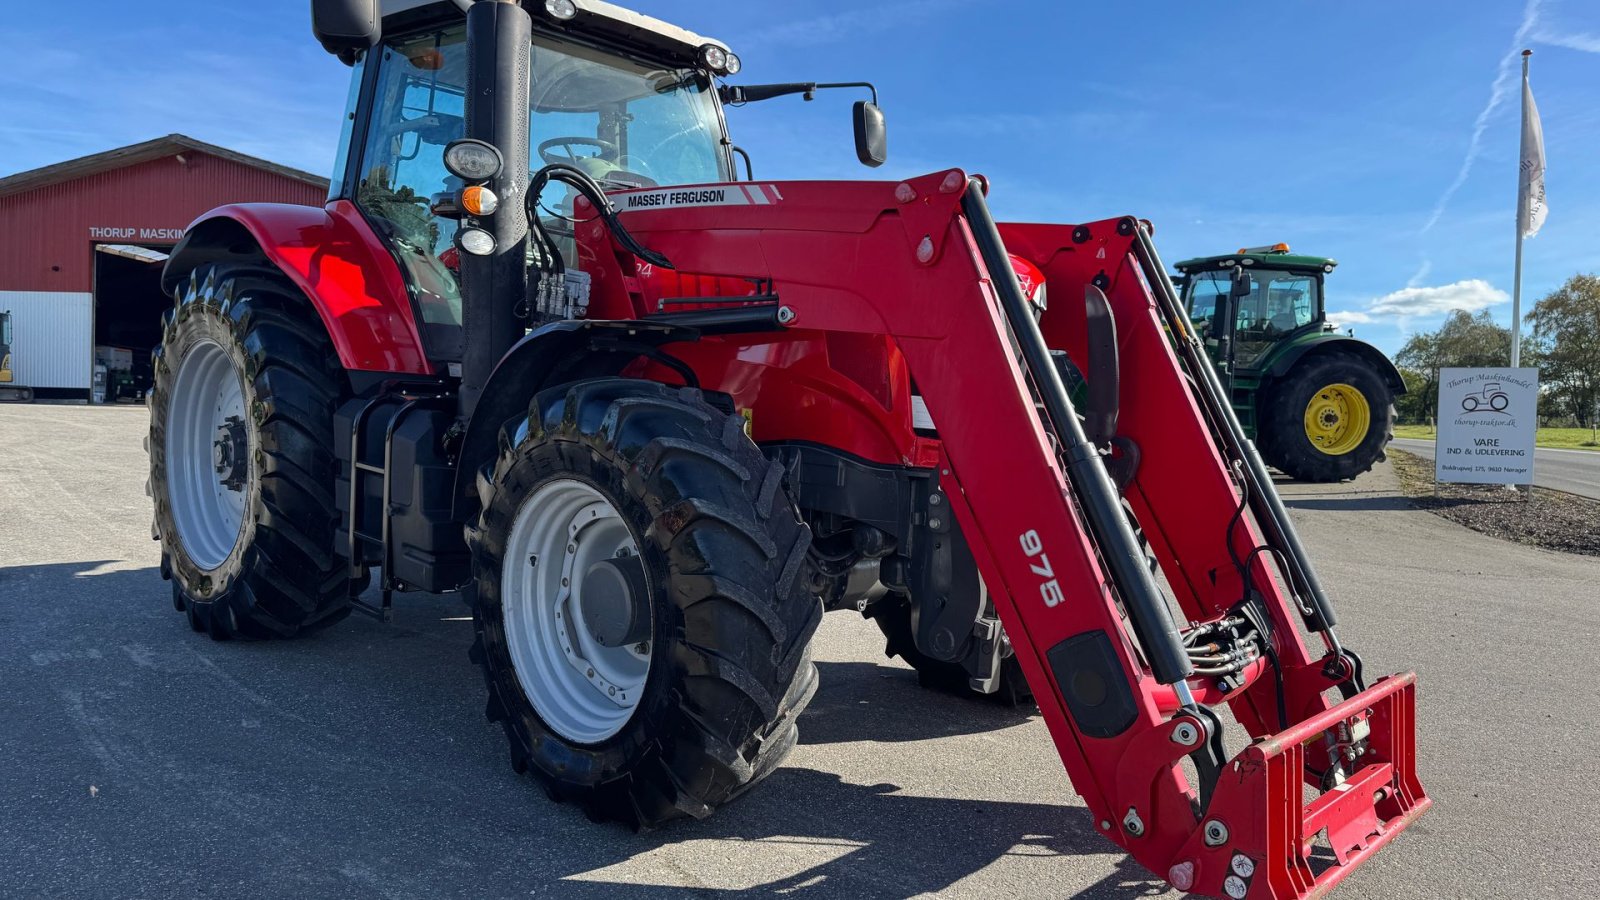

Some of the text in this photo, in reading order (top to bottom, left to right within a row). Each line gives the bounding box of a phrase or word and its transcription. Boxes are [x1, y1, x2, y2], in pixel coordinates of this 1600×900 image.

[628, 189, 725, 208] MASSEY FERGUSON
[89, 227, 136, 238] THORUP
[1447, 373, 1533, 389] Thorup Maskinhandel
[1454, 418, 1518, 428] thorup-traktor.dk
[1474, 438, 1500, 447] VARE
[1447, 447, 1525, 457] IND & UDLEVERING
[1019, 529, 1066, 608] 975
